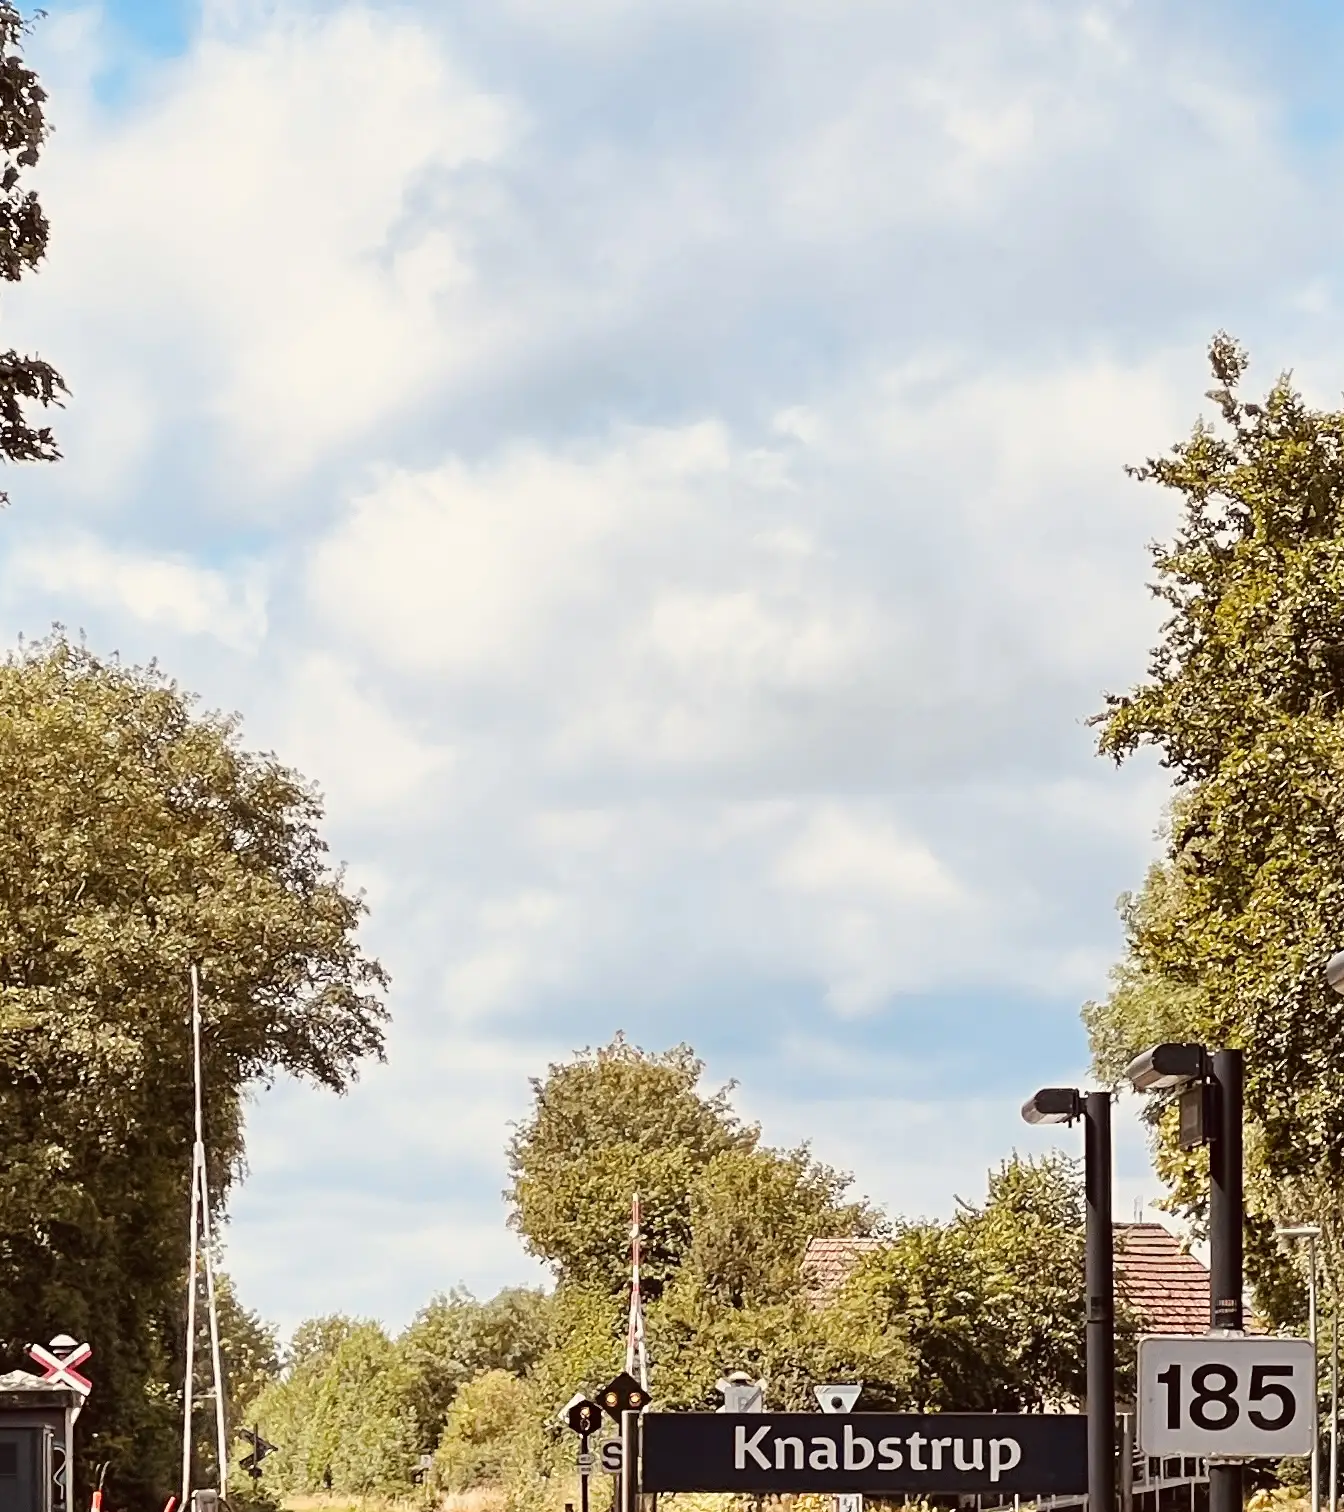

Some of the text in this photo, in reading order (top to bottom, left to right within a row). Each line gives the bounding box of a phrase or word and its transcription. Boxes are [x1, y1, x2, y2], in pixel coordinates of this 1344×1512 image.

[1157, 1363, 1296, 1431] 185
[602, 1442, 623, 1470] S
[734, 1424, 1022, 1482] Knabstrup
